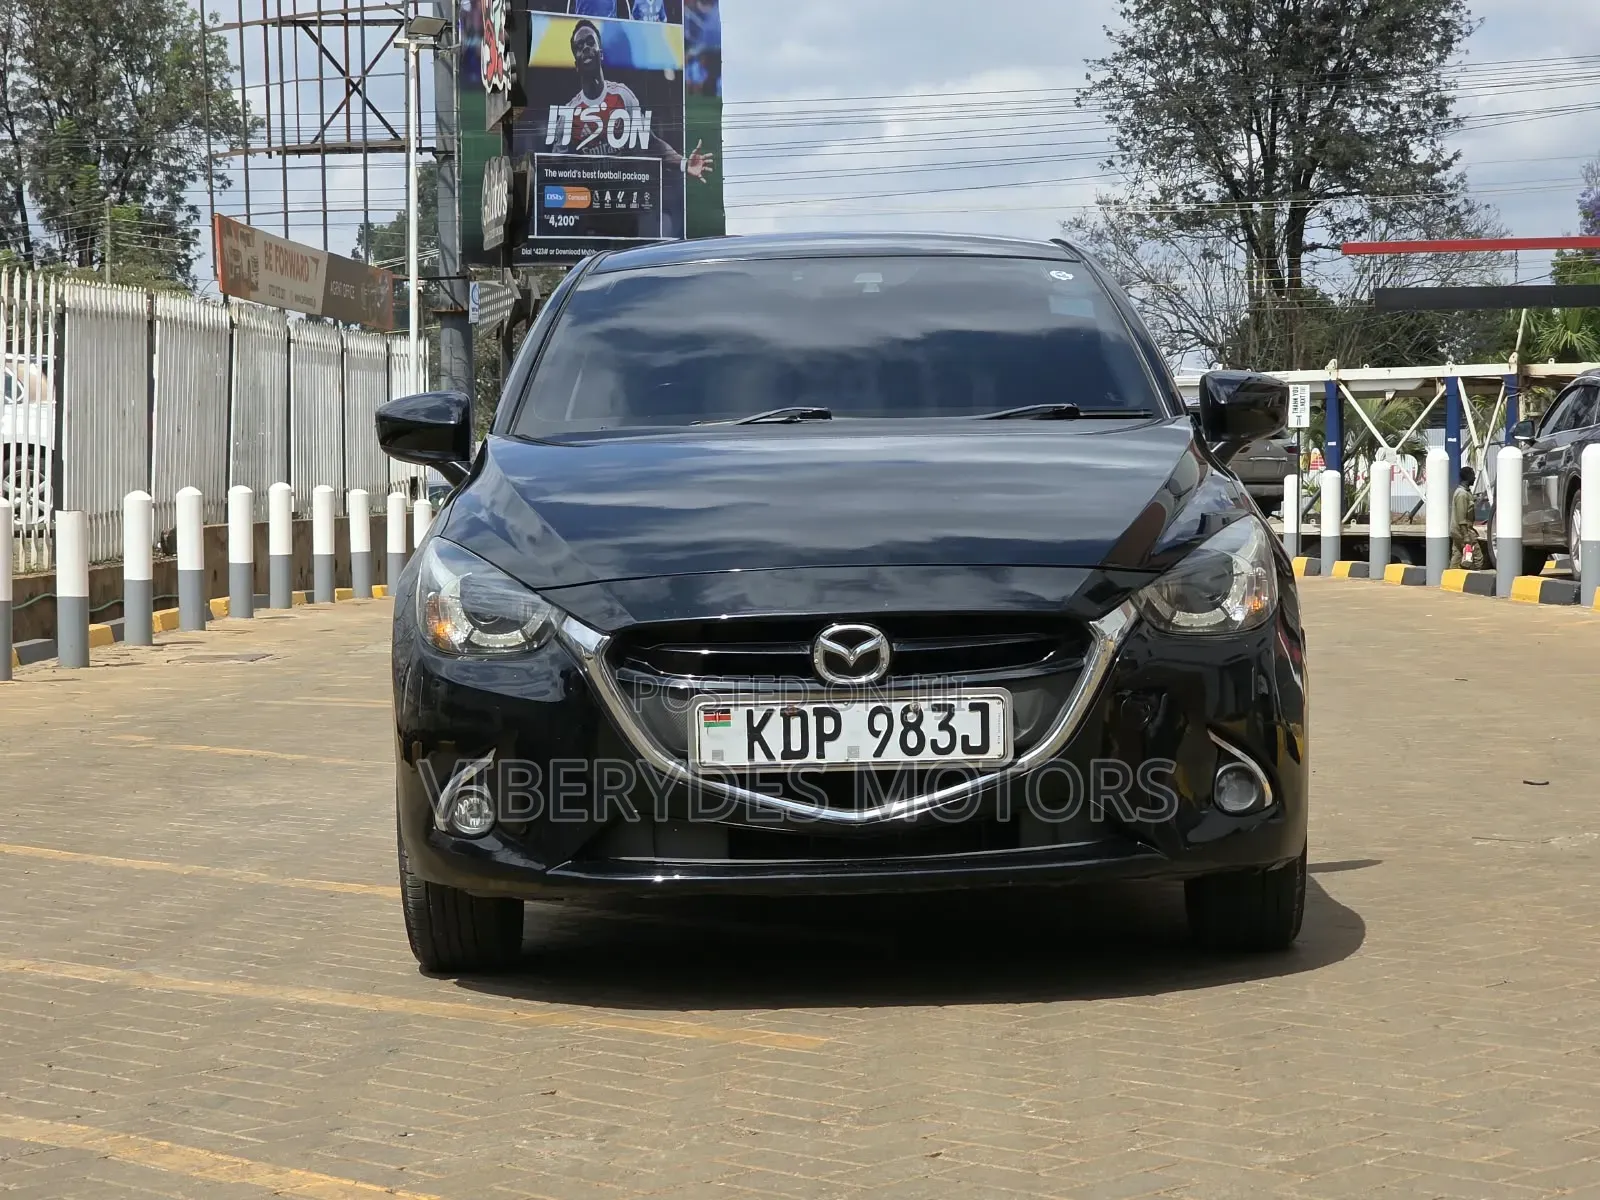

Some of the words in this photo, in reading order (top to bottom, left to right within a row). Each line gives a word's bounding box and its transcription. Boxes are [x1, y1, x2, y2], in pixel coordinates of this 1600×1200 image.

[545, 102, 607, 151] IT'S
[607, 106, 653, 150] ON
[544, 168, 558, 178] The
[558, 169, 582, 179] world's
[582, 170, 597, 179] best
[597, 170, 622, 181] football
[622, 171, 650, 183] package
[548, 214, 575, 228] 4,200
[263, 240, 273, 272] BE
[274, 244, 310, 283] FORWARD
[521, 248, 533, 256] Dial
[746, 706, 843, 762] KDP
[867, 701, 990, 758] 983J
